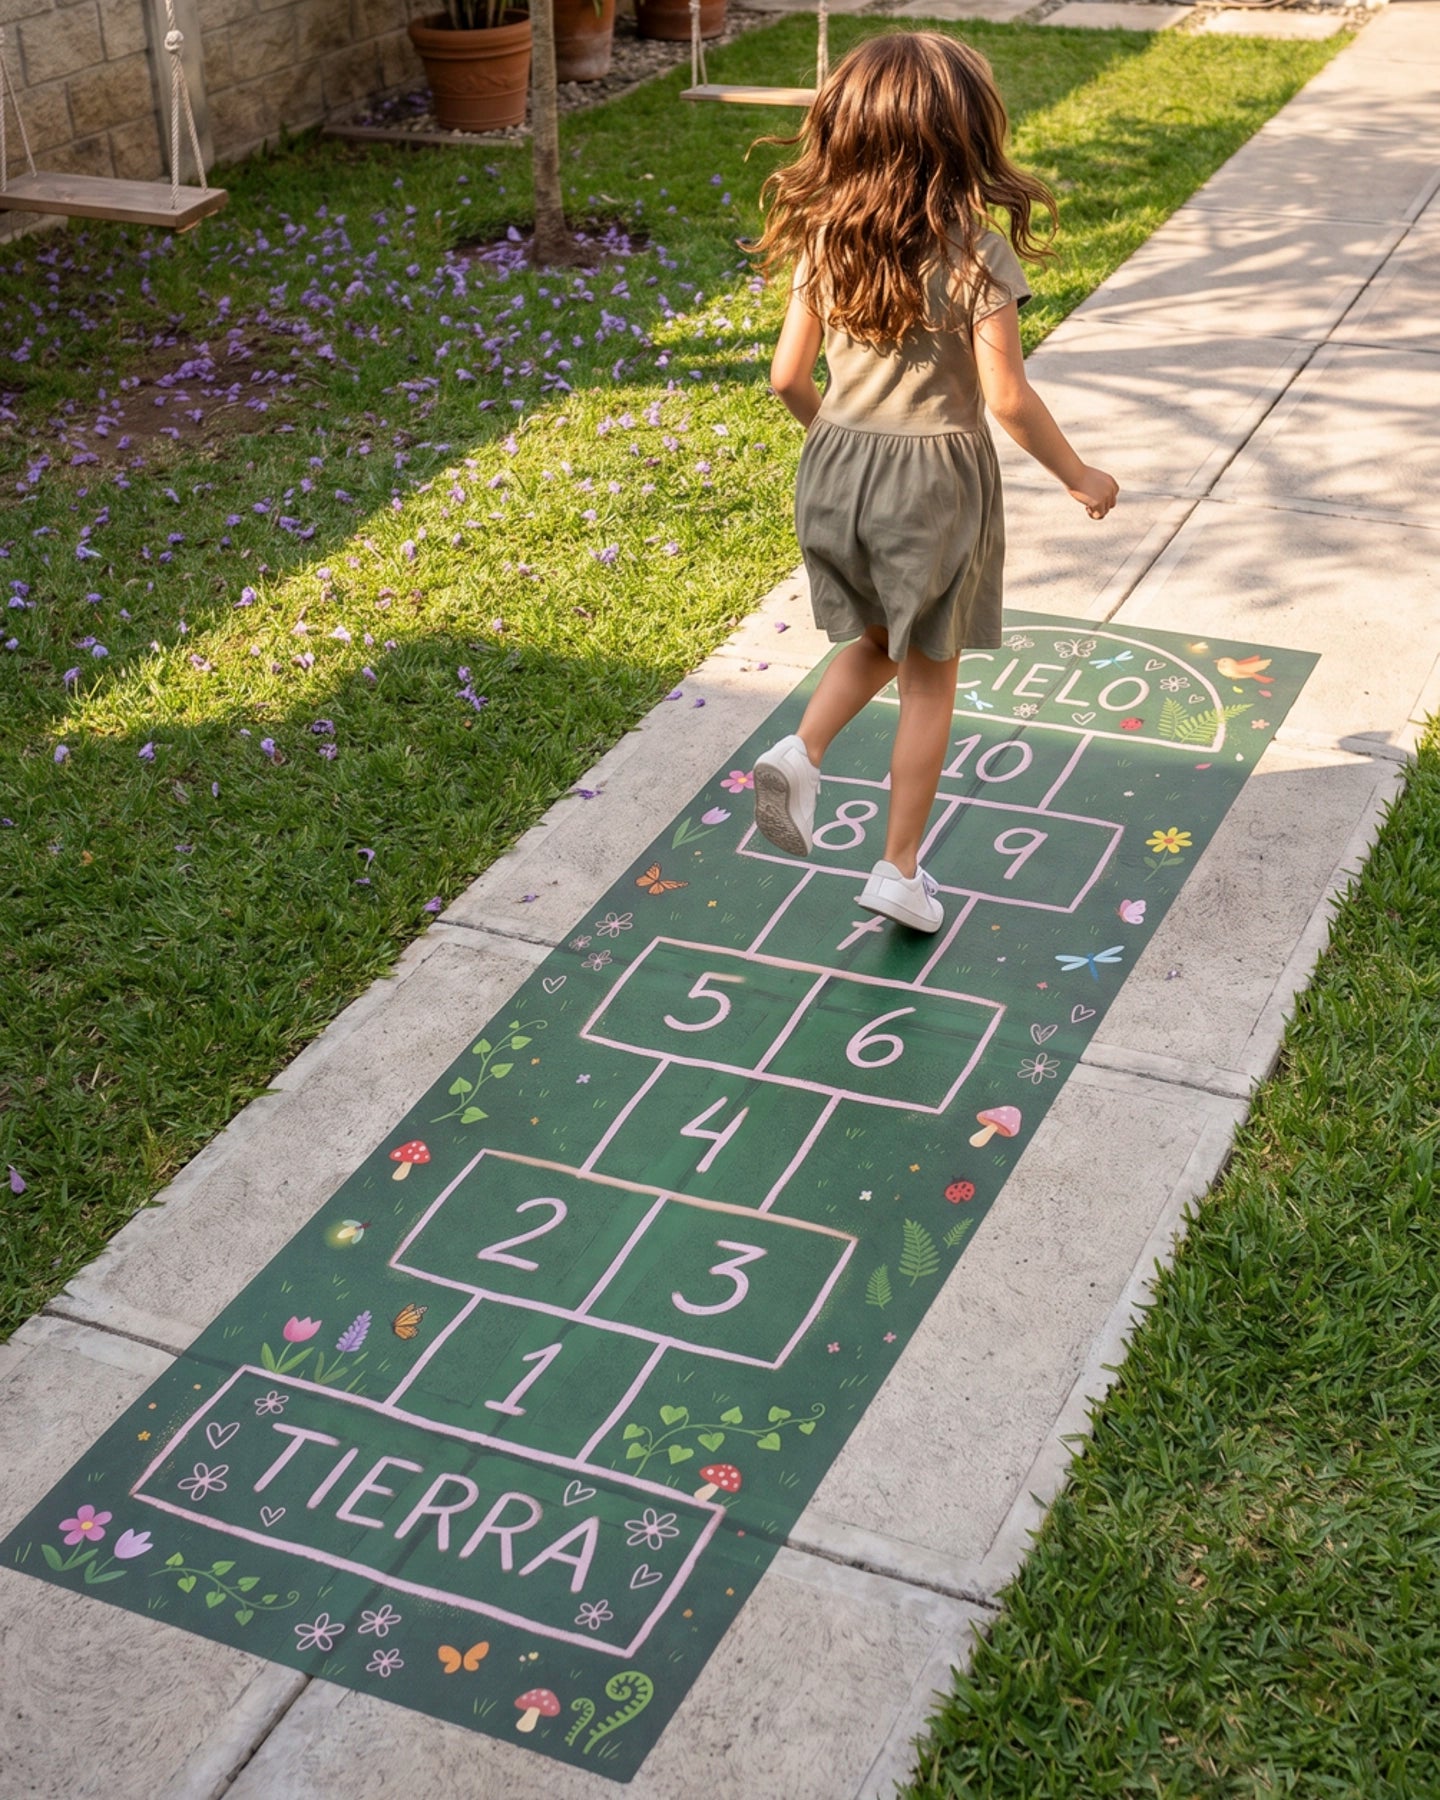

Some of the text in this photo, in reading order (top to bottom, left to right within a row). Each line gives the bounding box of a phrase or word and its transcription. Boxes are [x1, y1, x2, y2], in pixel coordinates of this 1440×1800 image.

[956, 653, 1150, 711] CIELO
[941, 733, 1033, 782] 10
[811, 800, 879, 850] 8
[993, 827, 1048, 880] 9
[664, 972, 746, 1032] 5
[846, 1006, 916, 1068] 6
[680, 1096, 749, 1173] 4
[476, 1198, 568, 1271] 2
[671, 1240, 767, 1316] 3
[485, 1342, 562, 1416] 1
[254, 1423, 600, 1594] TIERRA
